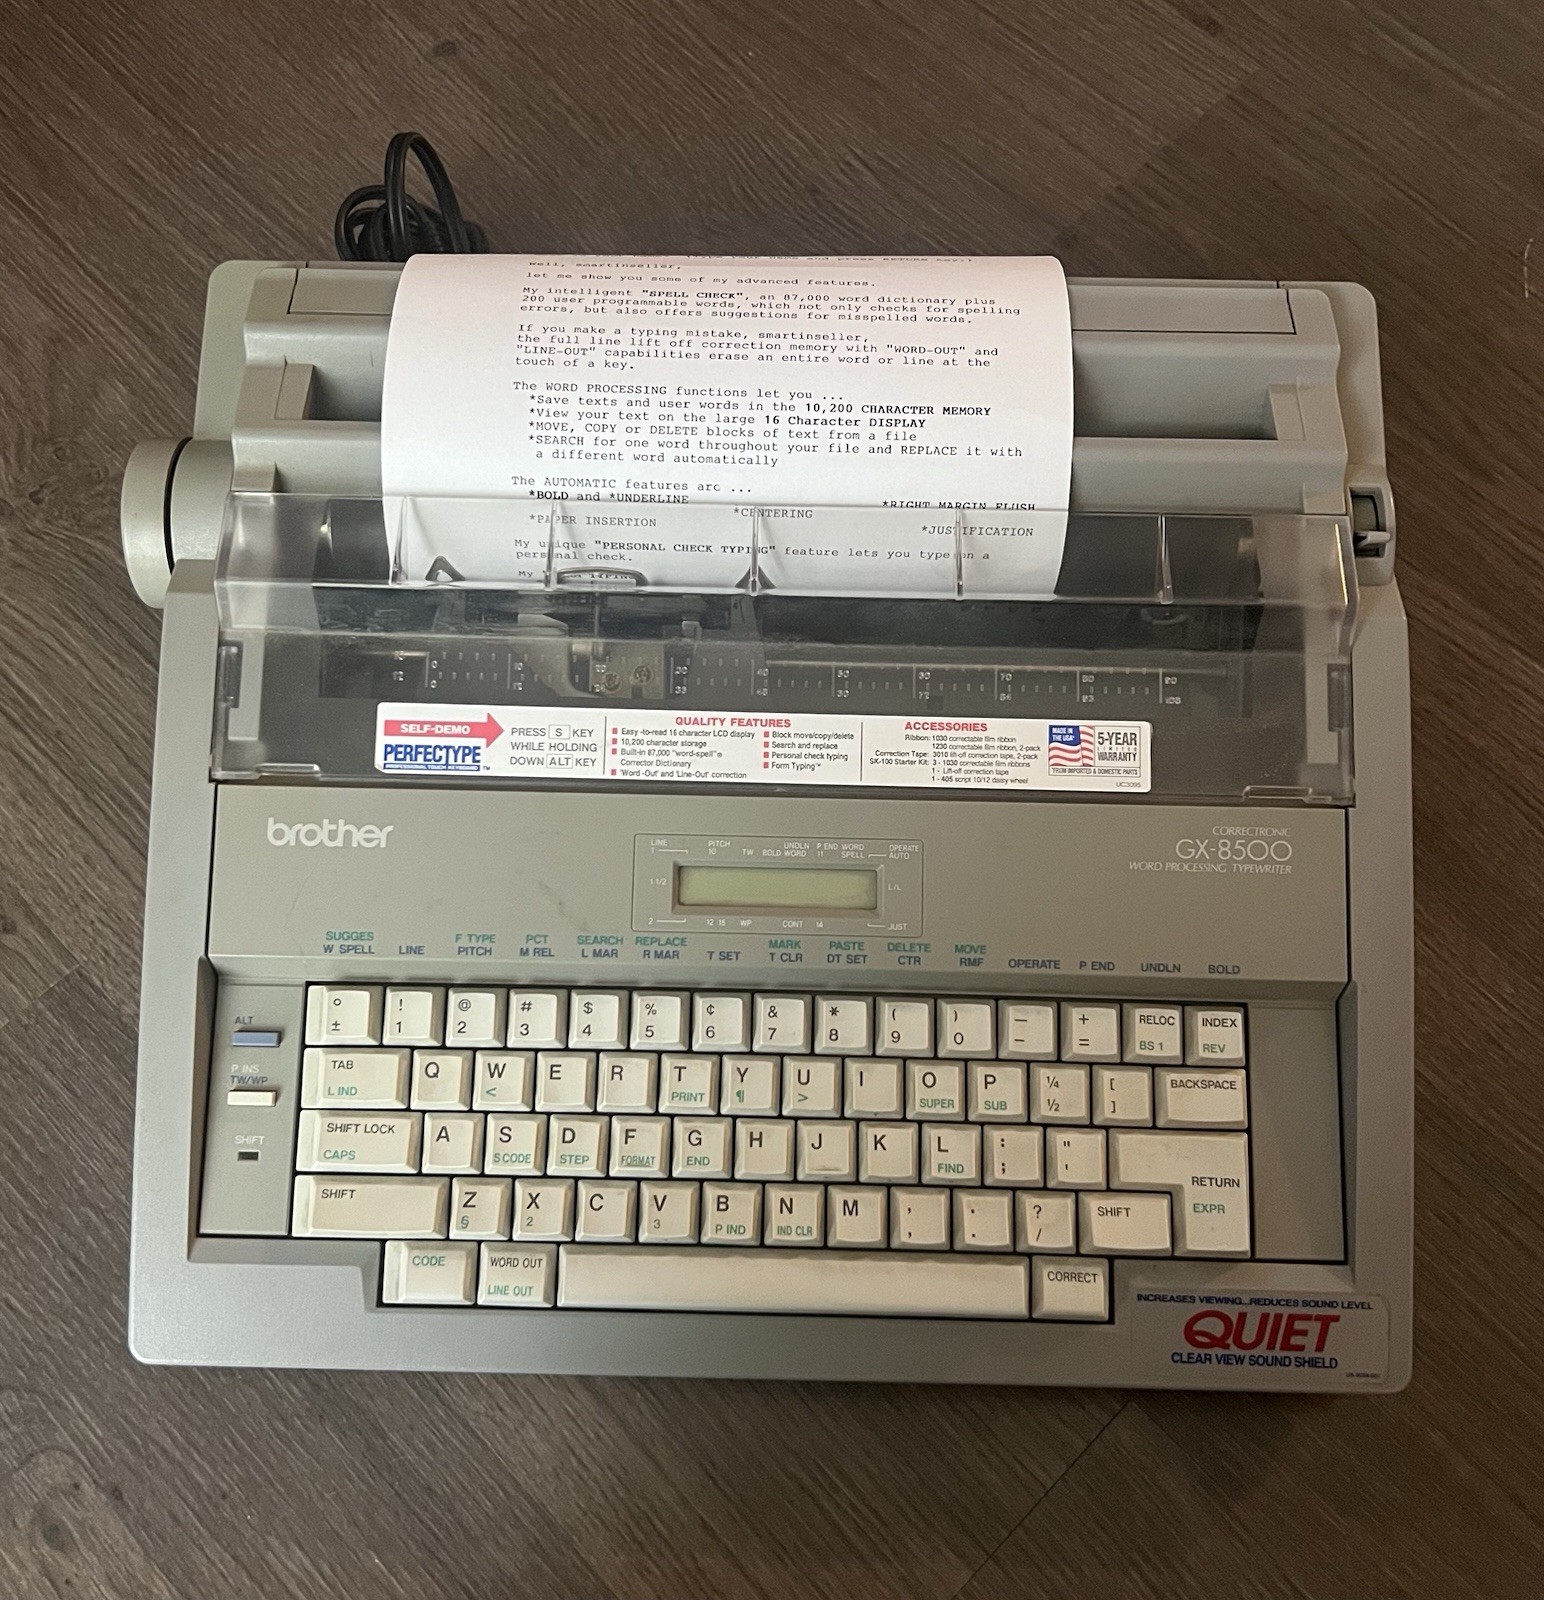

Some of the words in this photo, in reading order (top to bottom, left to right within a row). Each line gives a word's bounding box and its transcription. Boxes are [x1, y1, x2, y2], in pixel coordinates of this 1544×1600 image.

[548, 288, 630, 296] intelligent
[642, 290, 688, 298] "SPELL
[784, 294, 830, 302] 87,000
[877, 296, 956, 305] dictionary
[965, 298, 995, 306] plus
[513, 381, 537, 390] The
[546, 382, 578, 392] WORD
[587, 384, 667, 395] PROCESSING
[677, 386, 747, 397] functions
[757, 388, 779, 398] let
[789, 392, 812, 401] you
[578, 411, 609, 421] your
[619, 411, 649, 421] text
[684, 413, 706, 422] the
[716, 413, 755, 426] large
[766, 415, 779, 424] 16
[788, 415, 861, 426] Character
[869, 418, 926, 428] DISPLAY
[552, 449, 624, 461] different
[633, 452, 664, 462] word
[673, 454, 778, 467] automatically
[675, 716, 726, 726] QUALITY
[730, 718, 791, 728] FEATURES
[905, 722, 988, 732] ACCESSORIES
[400, 723, 470, 734] SELF-DEMO
[511, 727, 546, 737] PRESS
[555, 728, 562, 737] S
[572, 729, 594, 737] KEY
[1052, 726, 1067, 735] MADE
[621, 738, 645, 746] 10,200
[681, 740, 707, 749] storage
[1098, 732, 1137, 746] 5-YEAR
[510, 742, 545, 751] WHILE
[549, 742, 597, 752] HOLDING
[772, 741, 796, 749] Search
[813, 742, 838, 751] replace
[383, 744, 481, 767] PERFECTYPE
[1097, 752, 1137, 762] WARRANTY
[510, 756, 544, 765] DOWN
[549, 757, 571, 766] ALT
[575, 758, 597, 767] KEY
[620, 758, 654, 767] Corrector
[655, 759, 692, 769] Dictionary
[267, 817, 394, 848] brother
[1212, 826, 1290, 837] CORRECTRONIC
[889, 844, 919, 852] OPERATE
[1176, 839, 1292, 861] GX-8500
[1129, 861, 1163, 871] WORD
[1165, 862, 1227, 873] PROCESSING
[1233, 863, 1292, 874] TYPEWRITER
[326, 931, 374, 941] SUGGES
[455, 933, 463, 943] F
[467, 934, 496, 943] TYPE
[525, 934, 549, 944] PCT
[577, 935, 624, 946] SEARCH
[635, 936, 688, 947] REPLACE
[323, 944, 334, 953] W
[339, 944, 375, 954] SPELL
[768, 939, 801, 949] MARK
[829, 941, 865, 951] PASTE
[887, 942, 931, 953] DELETE
[955, 944, 986, 955] MOVE
[399, 945, 425, 955] LINE
[457, 946, 492, 956] PITCH
[520, 947, 529, 957] M
[533, 947, 555, 957] REL
[581, 948, 588, 958] L
[593, 948, 618, 958] MAR
[769, 952, 776, 962] T
[780, 952, 803, 962] CLR
[827, 954, 842, 963] DT
[846, 954, 868, 964] SET
[898, 955, 921, 965] CTR
[960, 957, 984, 967] RMF
[1008, 958, 1061, 969] OPERATE
[1079, 961, 1087, 970] P
[1091, 961, 1115, 971] END
[1141, 963, 1181, 973] UNDLN
[1208, 964, 1240, 975] BOLD
[234, 1016, 253, 1025] ALT
[1139, 1014, 1175, 1026] RELOC
[1202, 1017, 1237, 1028] INDEX
[1203, 1043, 1226, 1053] REV
[331, 1060, 354, 1070] TAB
[425, 1062, 439, 1078] Q
[487, 1063, 506, 1078] W
[549, 1064, 562, 1080] E
[674, 1066, 687, 1082] T
[736, 1067, 749, 1083] Y
[230, 1075, 270, 1087] TW/WP
[922, 1072, 936, 1088] O
[984, 1074, 996, 1090] P
[1170, 1079, 1237, 1090] BACKSPACE
[328, 1086, 335, 1096] L
[337, 1086, 358, 1096] IND
[671, 1091, 705, 1102] PRINT
[919, 1098, 955, 1109] SUPER
[984, 1100, 1007, 1111] SUB
[326, 1122, 361, 1133] SHIFT
[364, 1124, 395, 1134] LOCK
[234, 1135, 265, 1145] SHIFT
[323, 1149, 356, 1160] CAPS
[560, 1154, 589, 1165] STEP
[620, 1155, 655, 1168] FORMAT
[686, 1156, 710, 1166] END
[938, 1163, 964, 1174] FIND
[1192, 1176, 1240, 1188] RETURN
[321, 1189, 356, 1199] SHIFT
[463, 1192, 477, 1208] Z
[526, 1193, 540, 1209] X
[716, 1195, 729, 1212] B
[780, 1197, 793, 1214] N
[1097, 1206, 1131, 1217] SHIFT
[1193, 1203, 1225, 1214] EXPR
[412, 1255, 446, 1266] CODE
[490, 1257, 519, 1268] WORD
[522, 1257, 543, 1269] OUT
[1047, 1271, 1098, 1283] CORRECT
[487, 1284, 509, 1295] LINE
[513, 1286, 534, 1296] OUT
[1137, 1294, 1196, 1304] INCREASES
[1301, 1299, 1339, 1309] SOUND
[1341, 1301, 1373, 1310] LEVEL
[1184, 1310, 1341, 1353] QUIET
[1171, 1352, 1212, 1364] CLEAR
[1215, 1353, 1246, 1365] VIEW
[1248, 1354, 1292, 1367] SOUND
[1294, 1356, 1338, 1369] SHIELD
